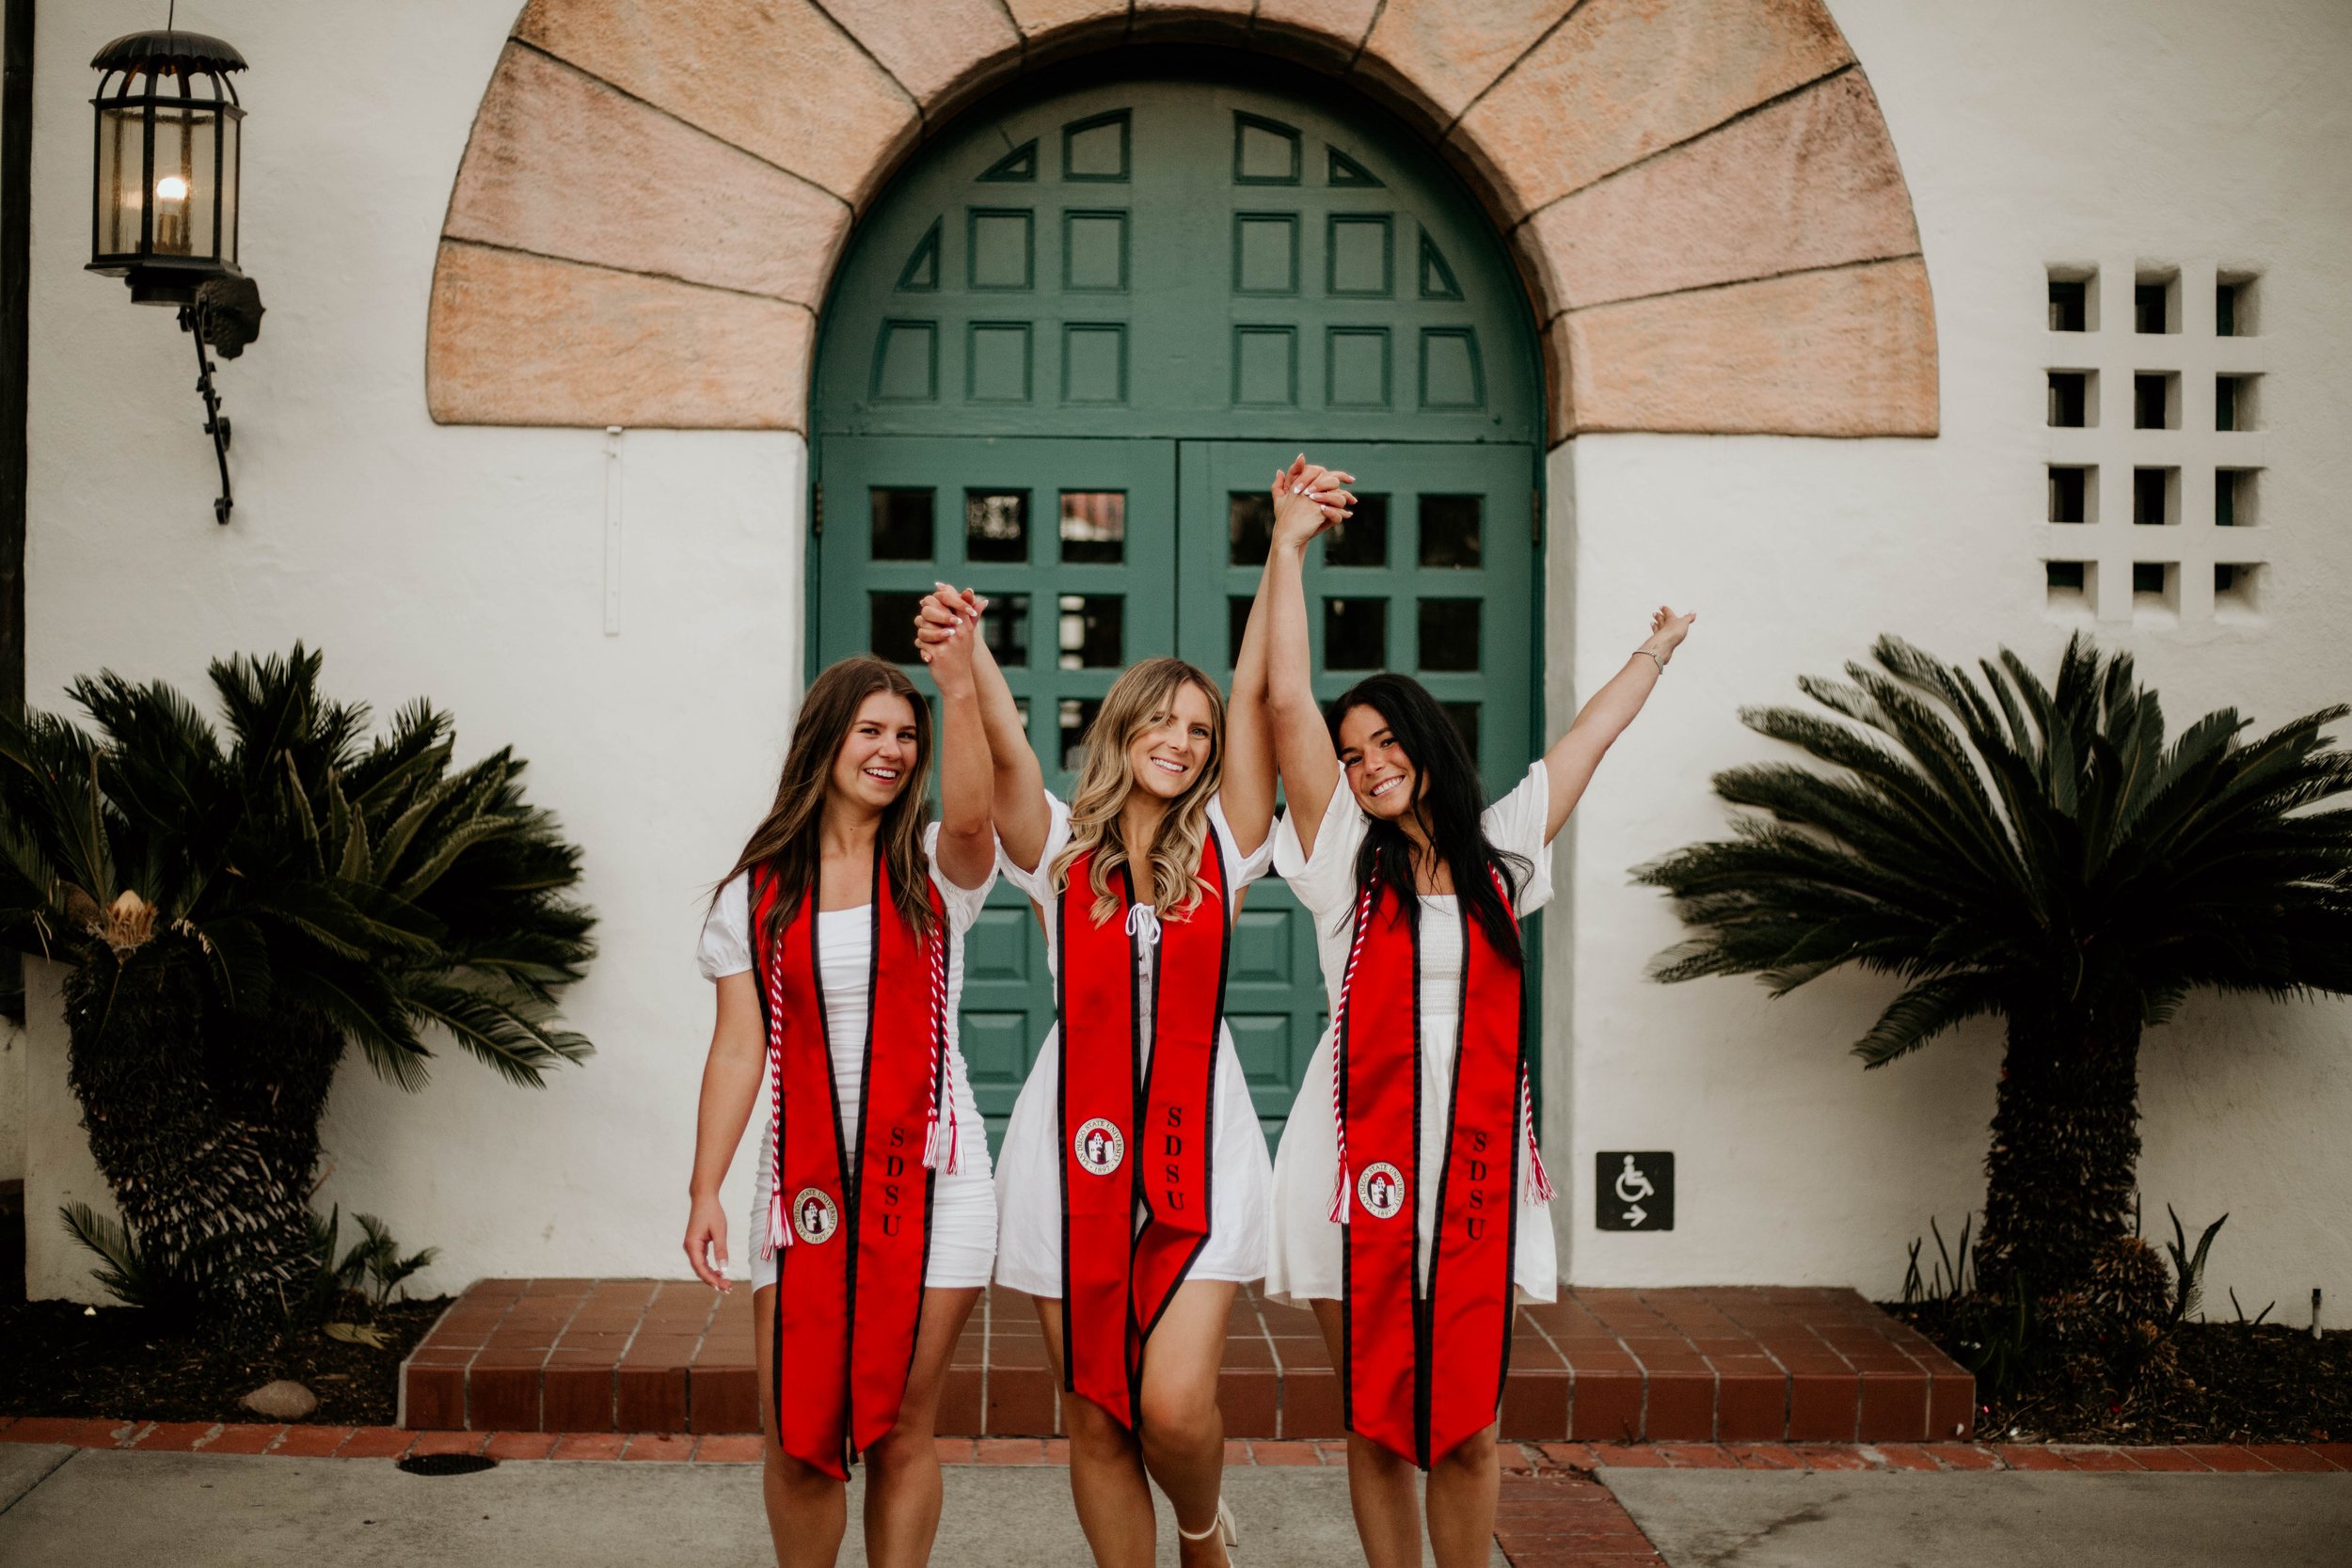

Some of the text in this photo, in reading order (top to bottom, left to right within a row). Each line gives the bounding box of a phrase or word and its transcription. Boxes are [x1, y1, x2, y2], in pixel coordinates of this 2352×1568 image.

[1076, 1130, 1086, 1151] DIEGO
[1085, 1120, 1104, 1130] STATE
[1105, 1123, 1122, 1164] UNIVERSITY
[1164, 1106, 1184, 1211] SDSU
[800, 1189, 816, 1199] STATE
[818, 1192, 836, 1229] UNIVERSITY
[882, 1127, 905, 1237] SDSU
[1359, 1173, 1369, 1195] DIEGO
[1368, 1164, 1388, 1173] STATE
[1389, 1167, 1403, 1208] UNIVERSITY
[1467, 1132, 1487, 1241] SDSU
